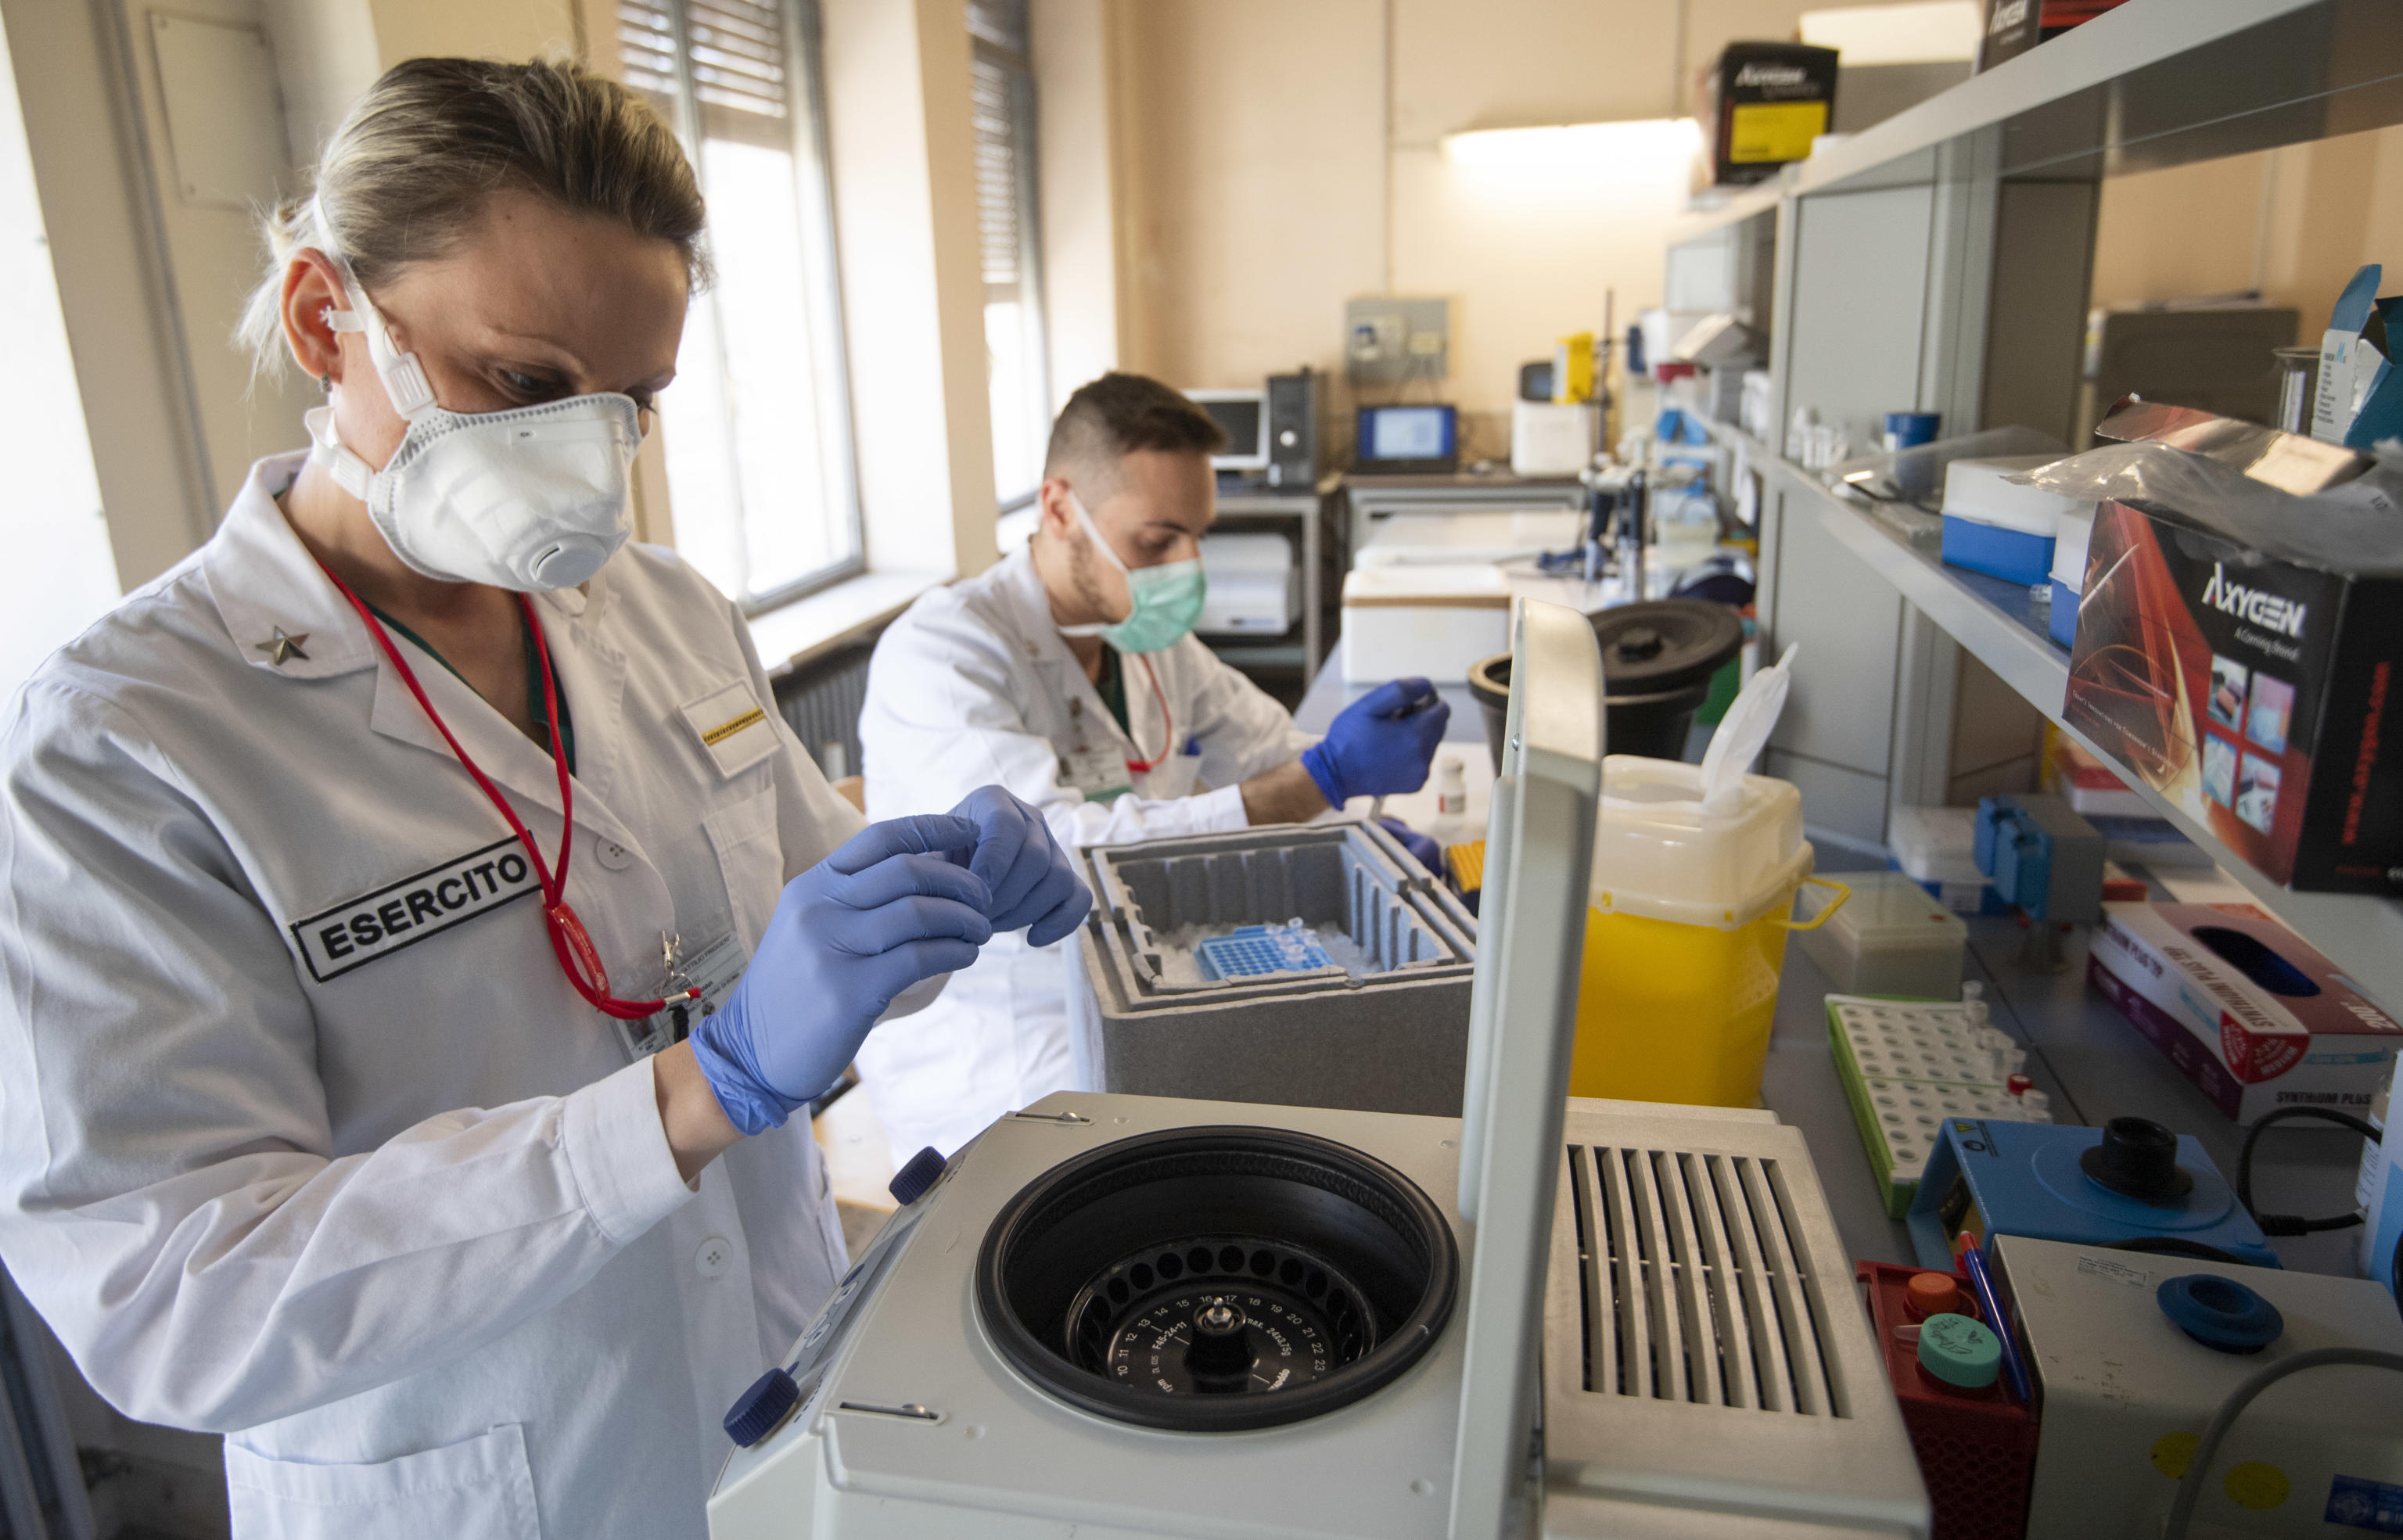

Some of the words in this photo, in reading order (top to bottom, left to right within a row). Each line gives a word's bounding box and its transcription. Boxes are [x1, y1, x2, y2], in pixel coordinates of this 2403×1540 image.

[2201, 562, 2307, 637] AXYGEN
[319, 853, 527, 960] ESERCITO
[2275, 1091, 2338, 1104] SYNTHIUM
[2340, 1093, 2372, 1104] PLUS
[1176, 1299, 1190, 1308] 15
[1270, 1304, 1283, 1313] 19
[1154, 1307, 1169, 1316] 14
[1137, 1319, 1151, 1327] 13
[1286, 1313, 1302, 1324] 20
[1125, 1333, 1138, 1342] 12
[1302, 1326, 1316, 1338] 21
[1118, 1349, 1130, 1358] 11
[1311, 1342, 1324, 1355] 22
[1117, 1365, 1128, 1376] 10
[1314, 1359, 1326, 1371] 23
[1157, 1378, 1173, 1392] rpm
